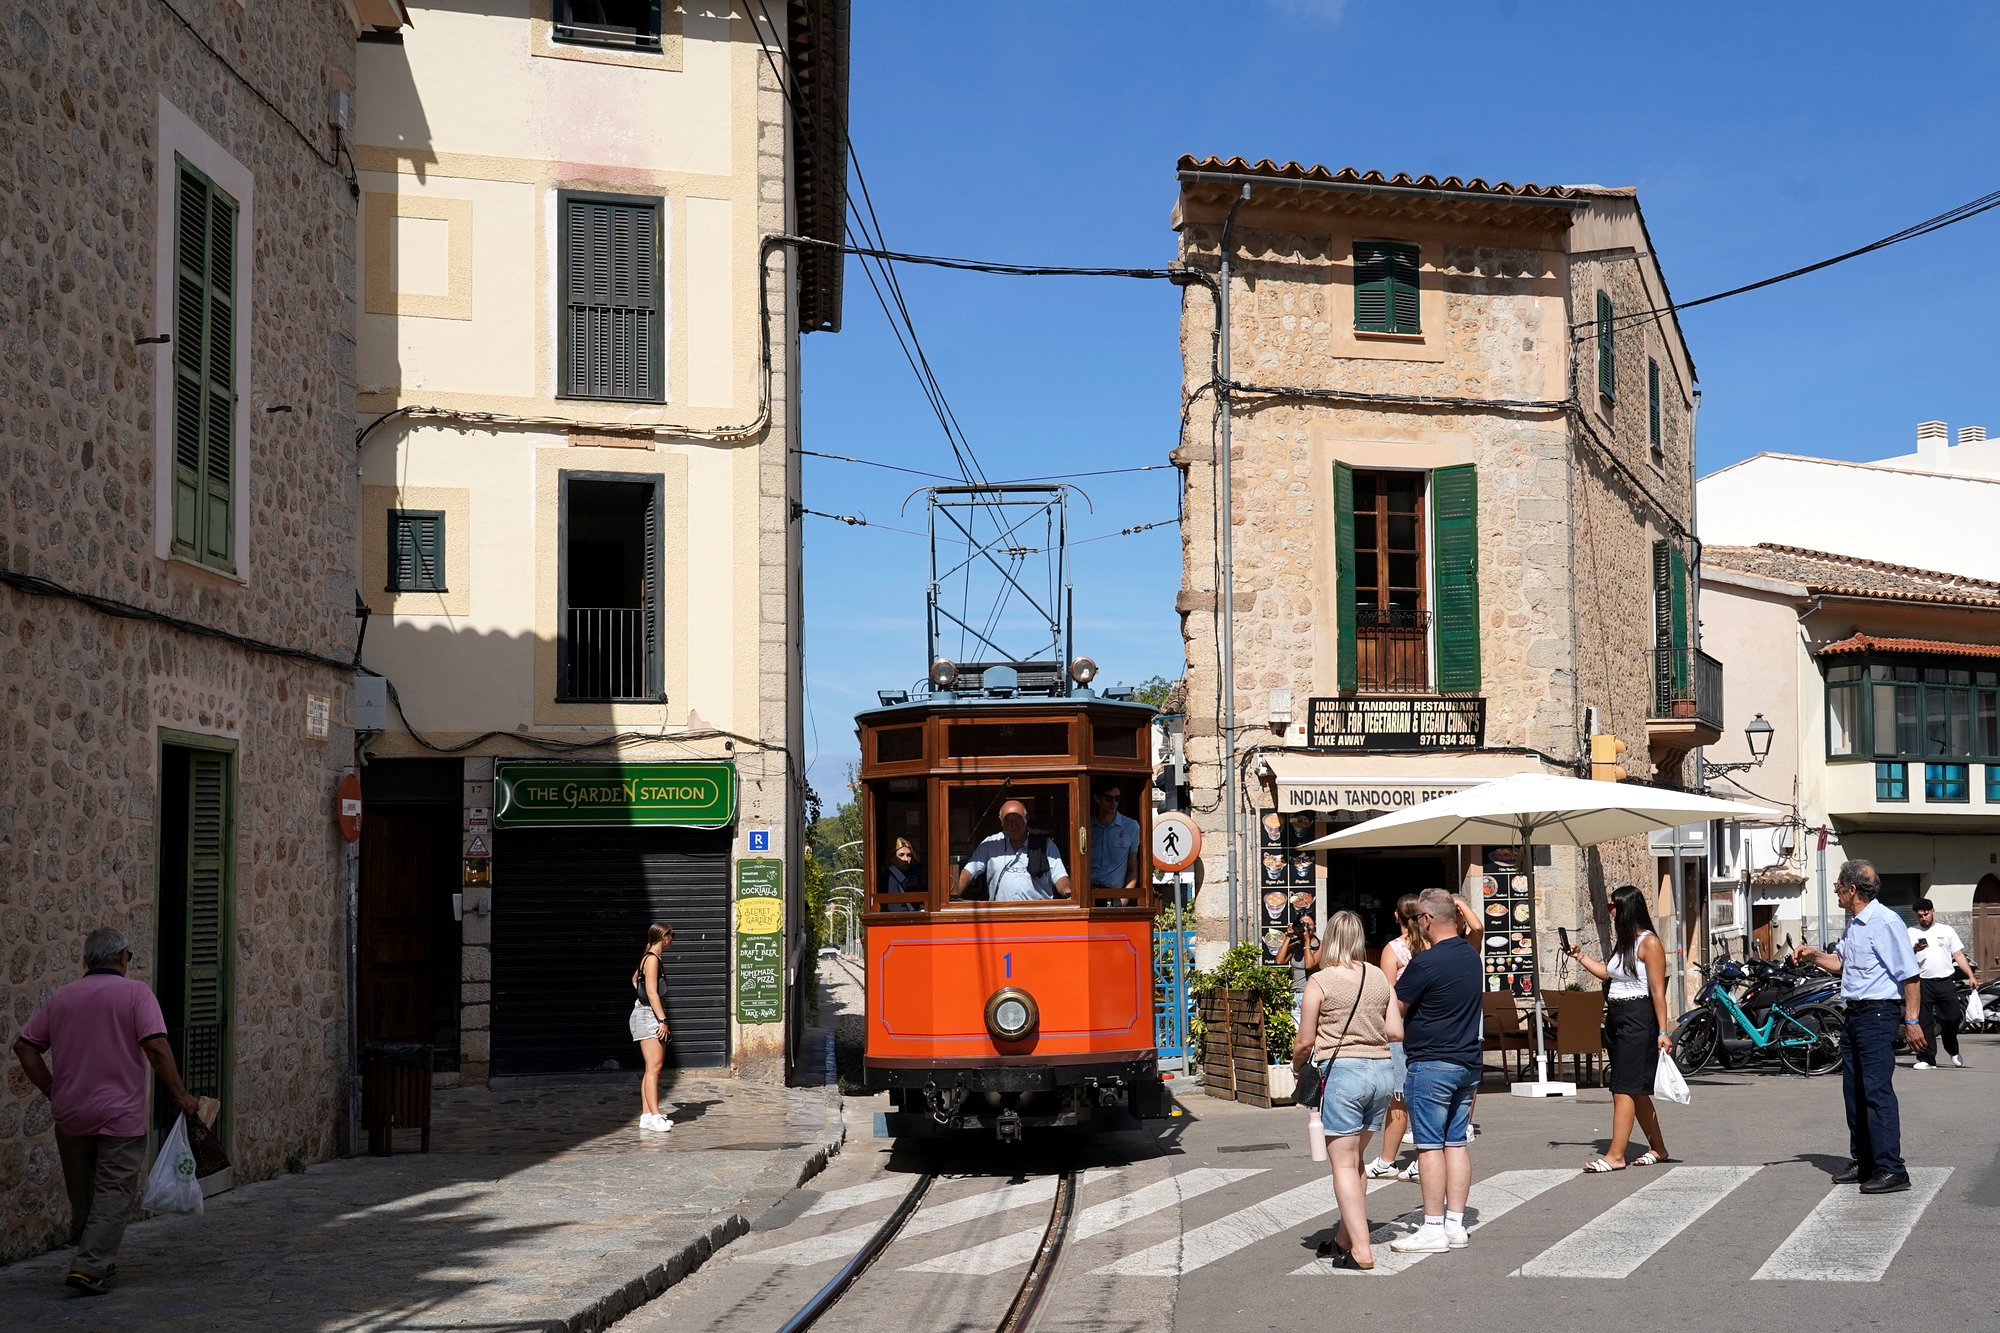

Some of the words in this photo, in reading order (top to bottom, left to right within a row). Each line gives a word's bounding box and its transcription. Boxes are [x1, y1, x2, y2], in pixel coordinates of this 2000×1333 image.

[1315, 701, 1355, 712] INDIAN
[1358, 701, 1411, 712] TANDOORI
[1413, 701, 1480, 712] RESTAURANT
[1314, 712, 1346, 734] SPECIAL
[1347, 712, 1362, 733] FOR
[1364, 712, 1411, 733] VEGETARIAN
[1412, 712, 1418, 734] &
[1420, 712, 1447, 733] VEGAN
[1447, 712, 1480, 733] CURRY'S
[1314, 735, 1336, 746] TAKE
[1337, 735, 1366, 746] AWAY
[1419, 735, 1438, 746] 971
[1439, 735, 1457, 746] 634
[1458, 735, 1476, 745] 346
[471, 785, 483, 794] 17
[527, 787, 559, 800] THE
[563, 779, 639, 809] GARDEN
[640, 786, 705, 800] STATION
[1290, 790, 1338, 806] INDIAN
[1345, 790, 1416, 806] TANDOORI
[755, 834, 763, 845] R
[741, 884, 778, 896] COCKTAILS
[745, 907, 771, 916] SECRET
[745, 913, 775, 925] GARDEN
[740, 949, 759, 958] DRAFT
[761, 949, 780, 958] BEER
[1002, 951, 1012, 978] 1
[740, 968, 779, 979] HOMEMADE
[757, 975, 775, 984] PIZZA
